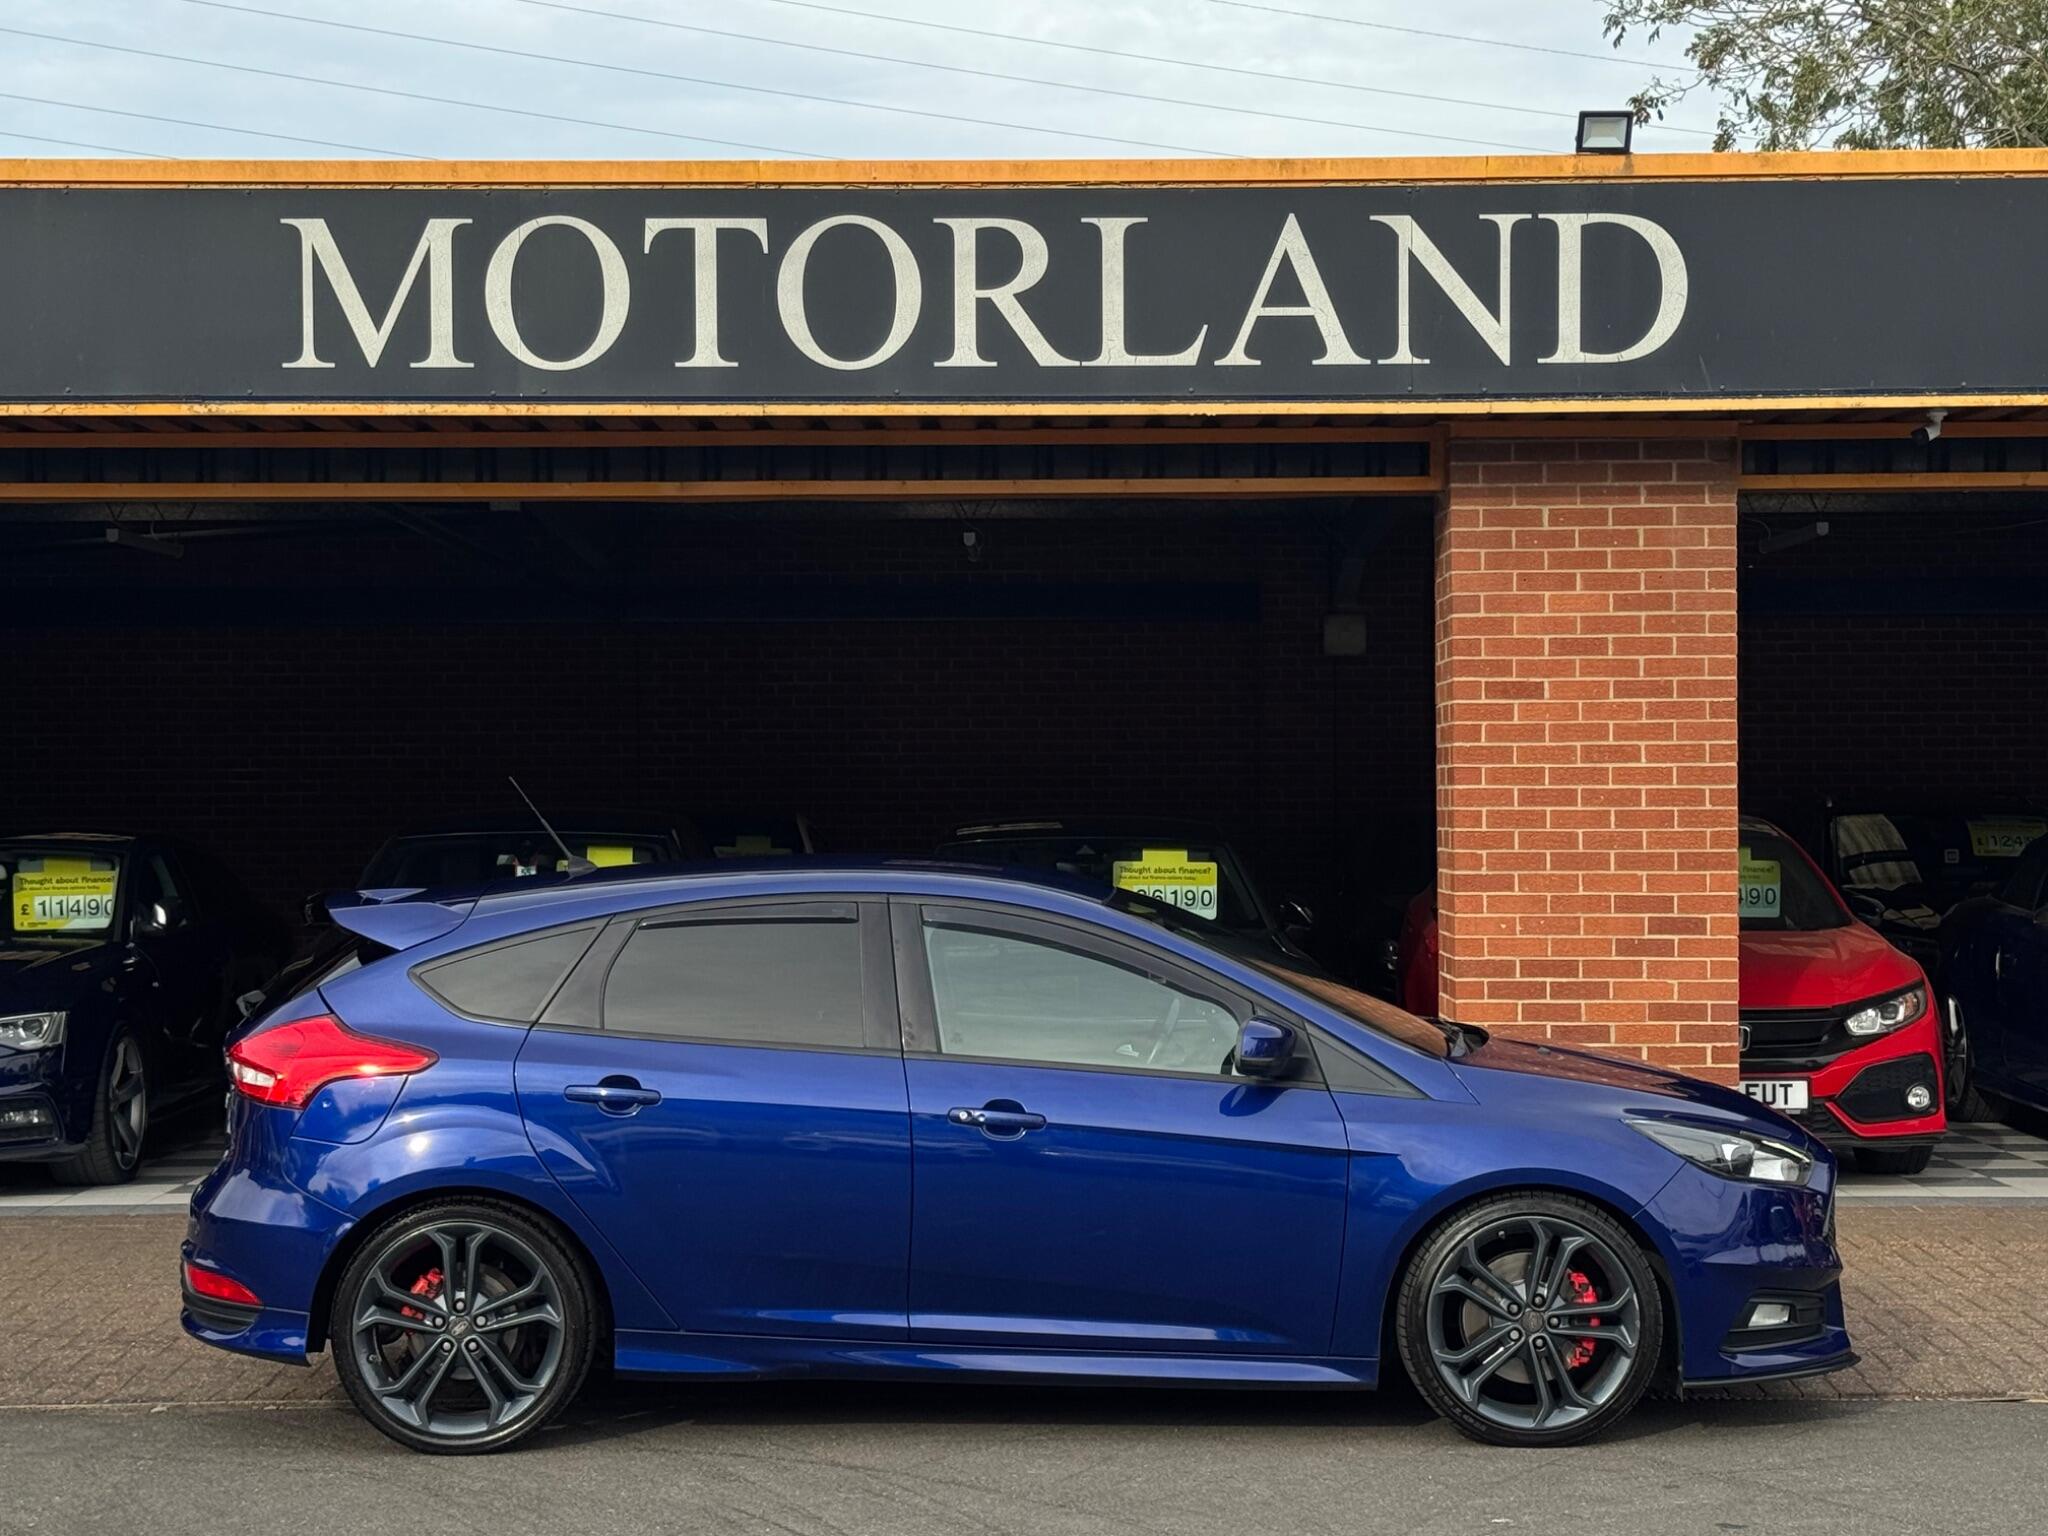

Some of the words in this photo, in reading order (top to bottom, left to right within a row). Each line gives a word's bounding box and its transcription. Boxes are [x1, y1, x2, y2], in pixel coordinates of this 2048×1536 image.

[281, 212, 1689, 371] MOTORLAND
[1119, 866, 1151, 877] Thought
[1153, 866, 1177, 875] about
[1178, 866, 1212, 876] finance?
[55, 875, 79, 885] about
[1136, 888, 1213, 907] 6190
[20, 903, 31, 916] £
